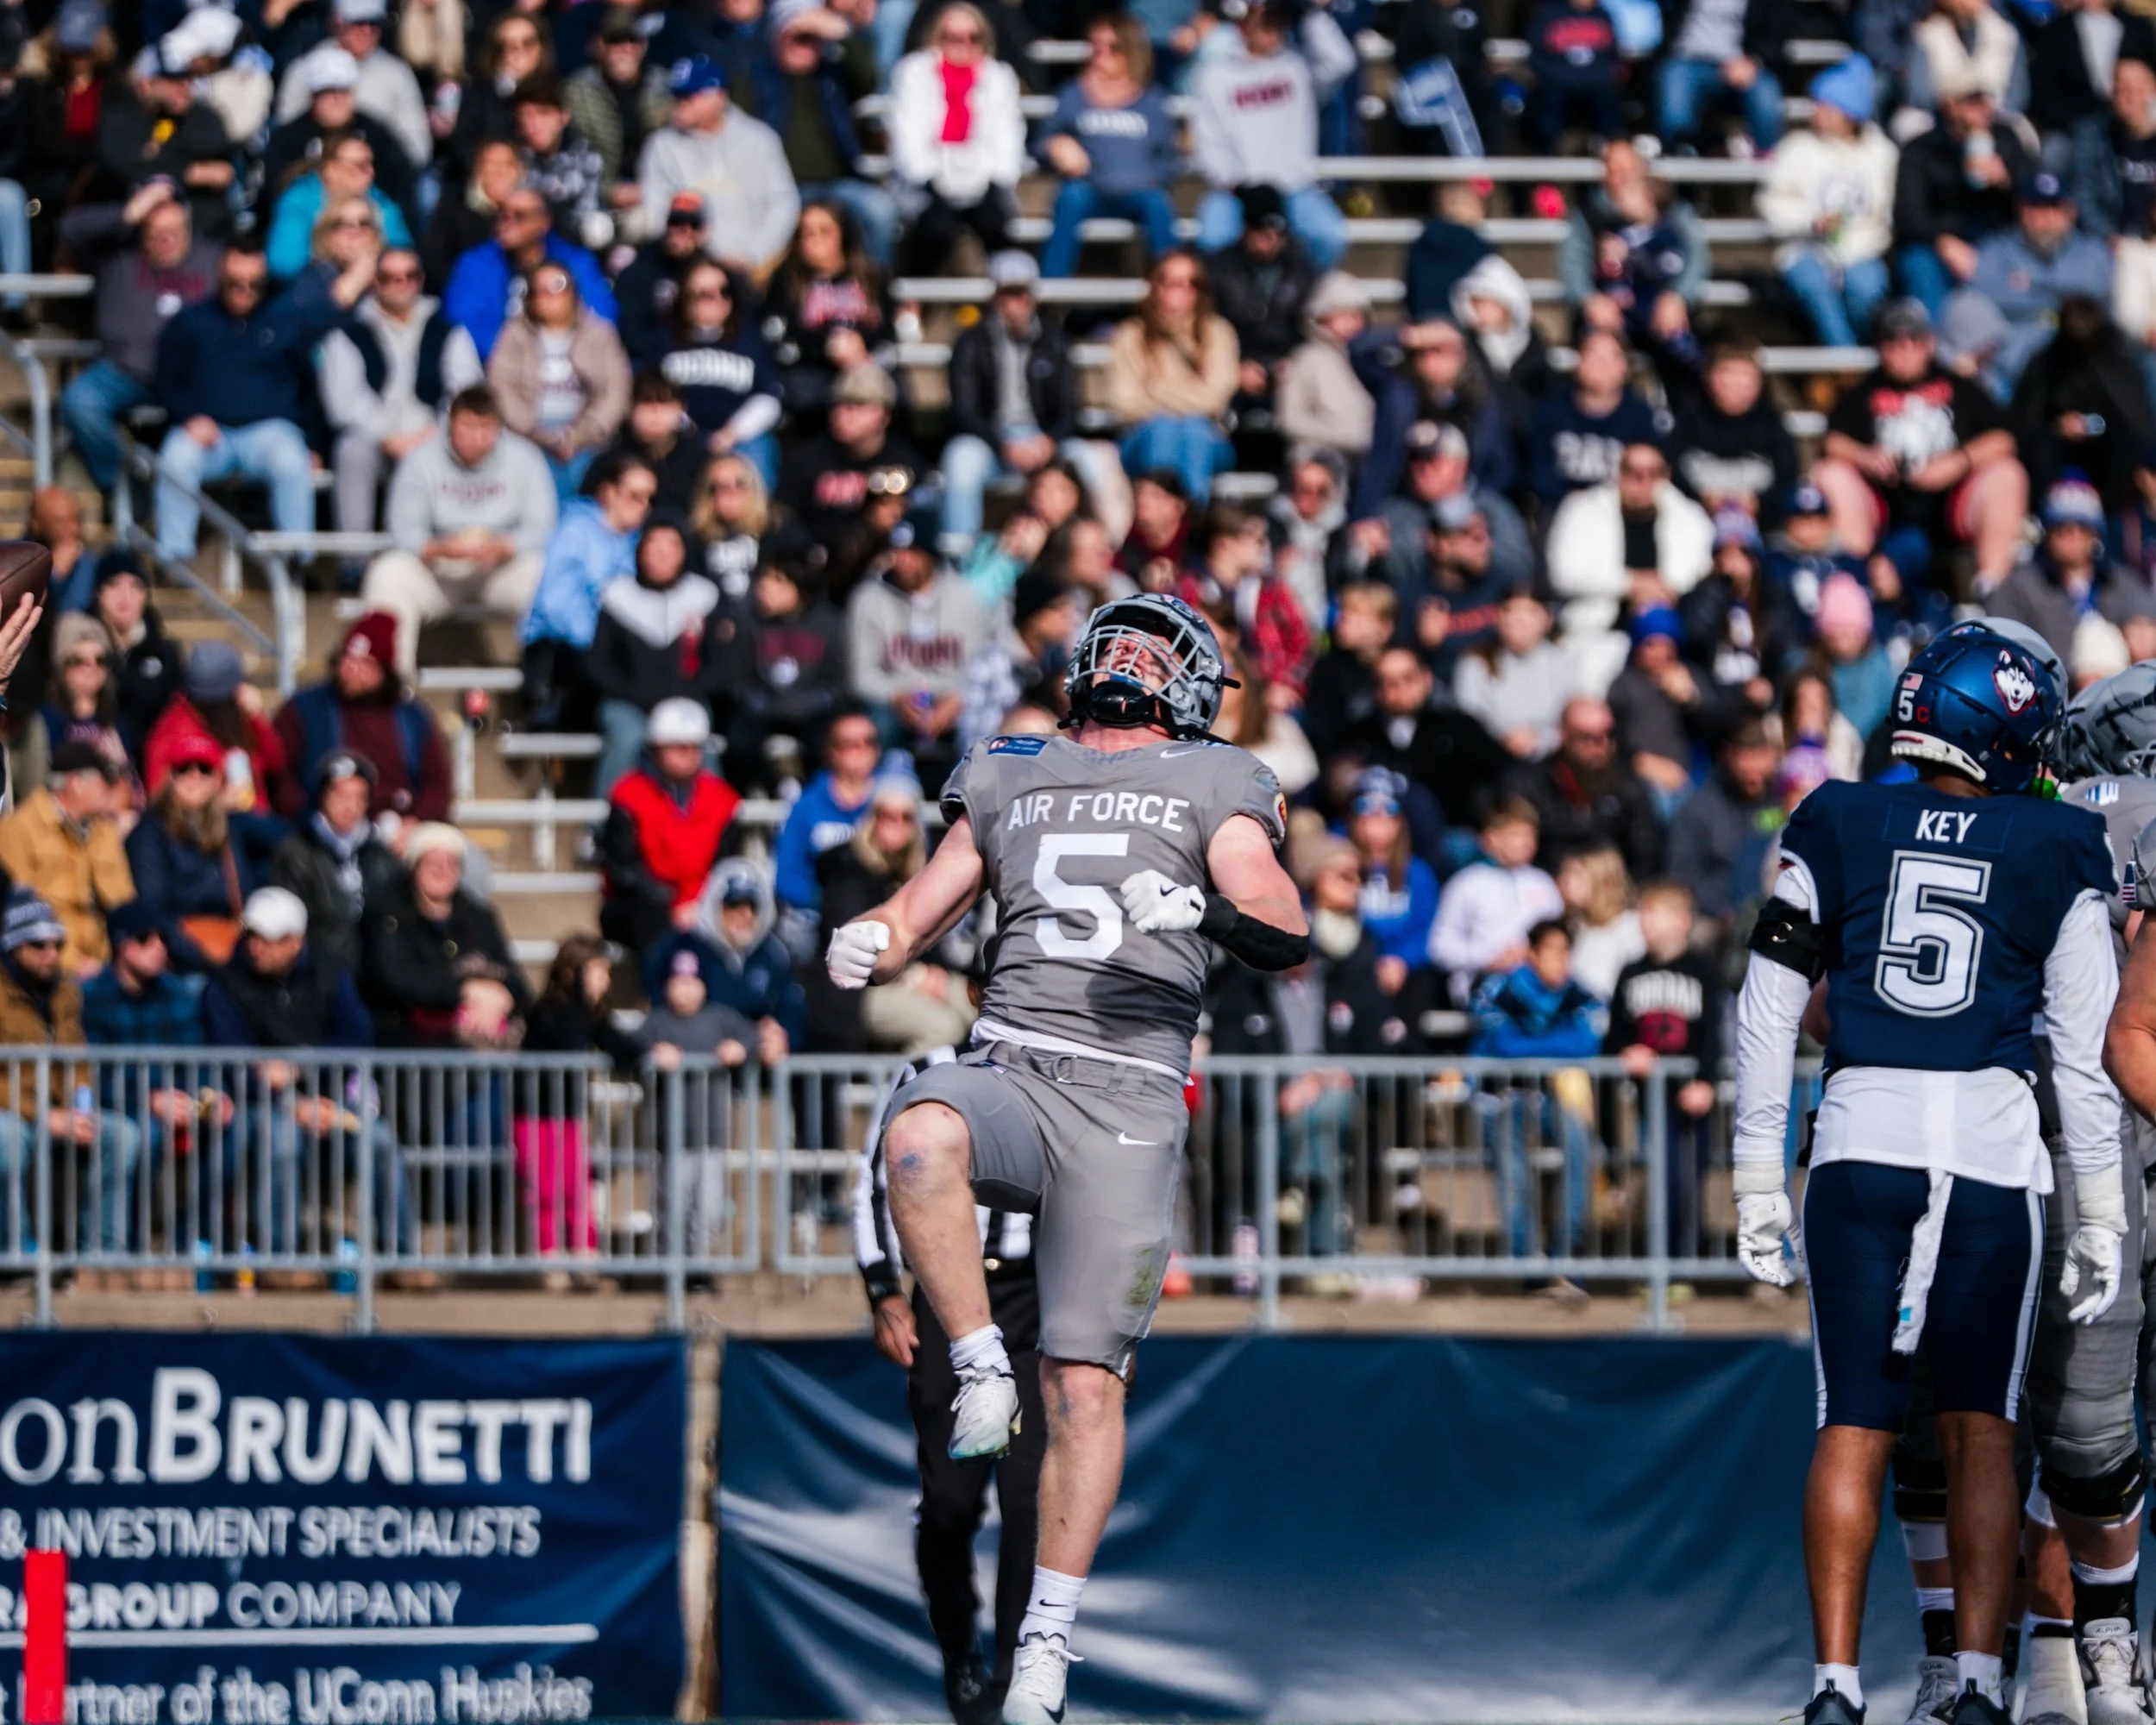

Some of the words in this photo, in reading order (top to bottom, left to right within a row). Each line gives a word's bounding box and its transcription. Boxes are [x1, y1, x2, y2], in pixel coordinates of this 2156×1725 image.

[1898, 690, 1915, 722] 5
[1916, 706, 1930, 724] C
[1007, 794, 1055, 831] AIR
[1068, 792, 1190, 832] FORCE
[1915, 809, 1977, 844] KEY
[1033, 833, 1130, 961] 5
[1874, 850, 1992, 1018] 5
[35, 1506, 296, 1559] INVESTMENT
[298, 1505, 542, 1559] SPECIALISTS
[227, 1581, 461, 1629] COMPANY
[17, 1672, 166, 1725] rtner
[170, 1665, 216, 1725] of
[221, 1665, 291, 1725] the
[294, 1665, 437, 1725] UConn
[439, 1661, 594, 1725] Huskies
